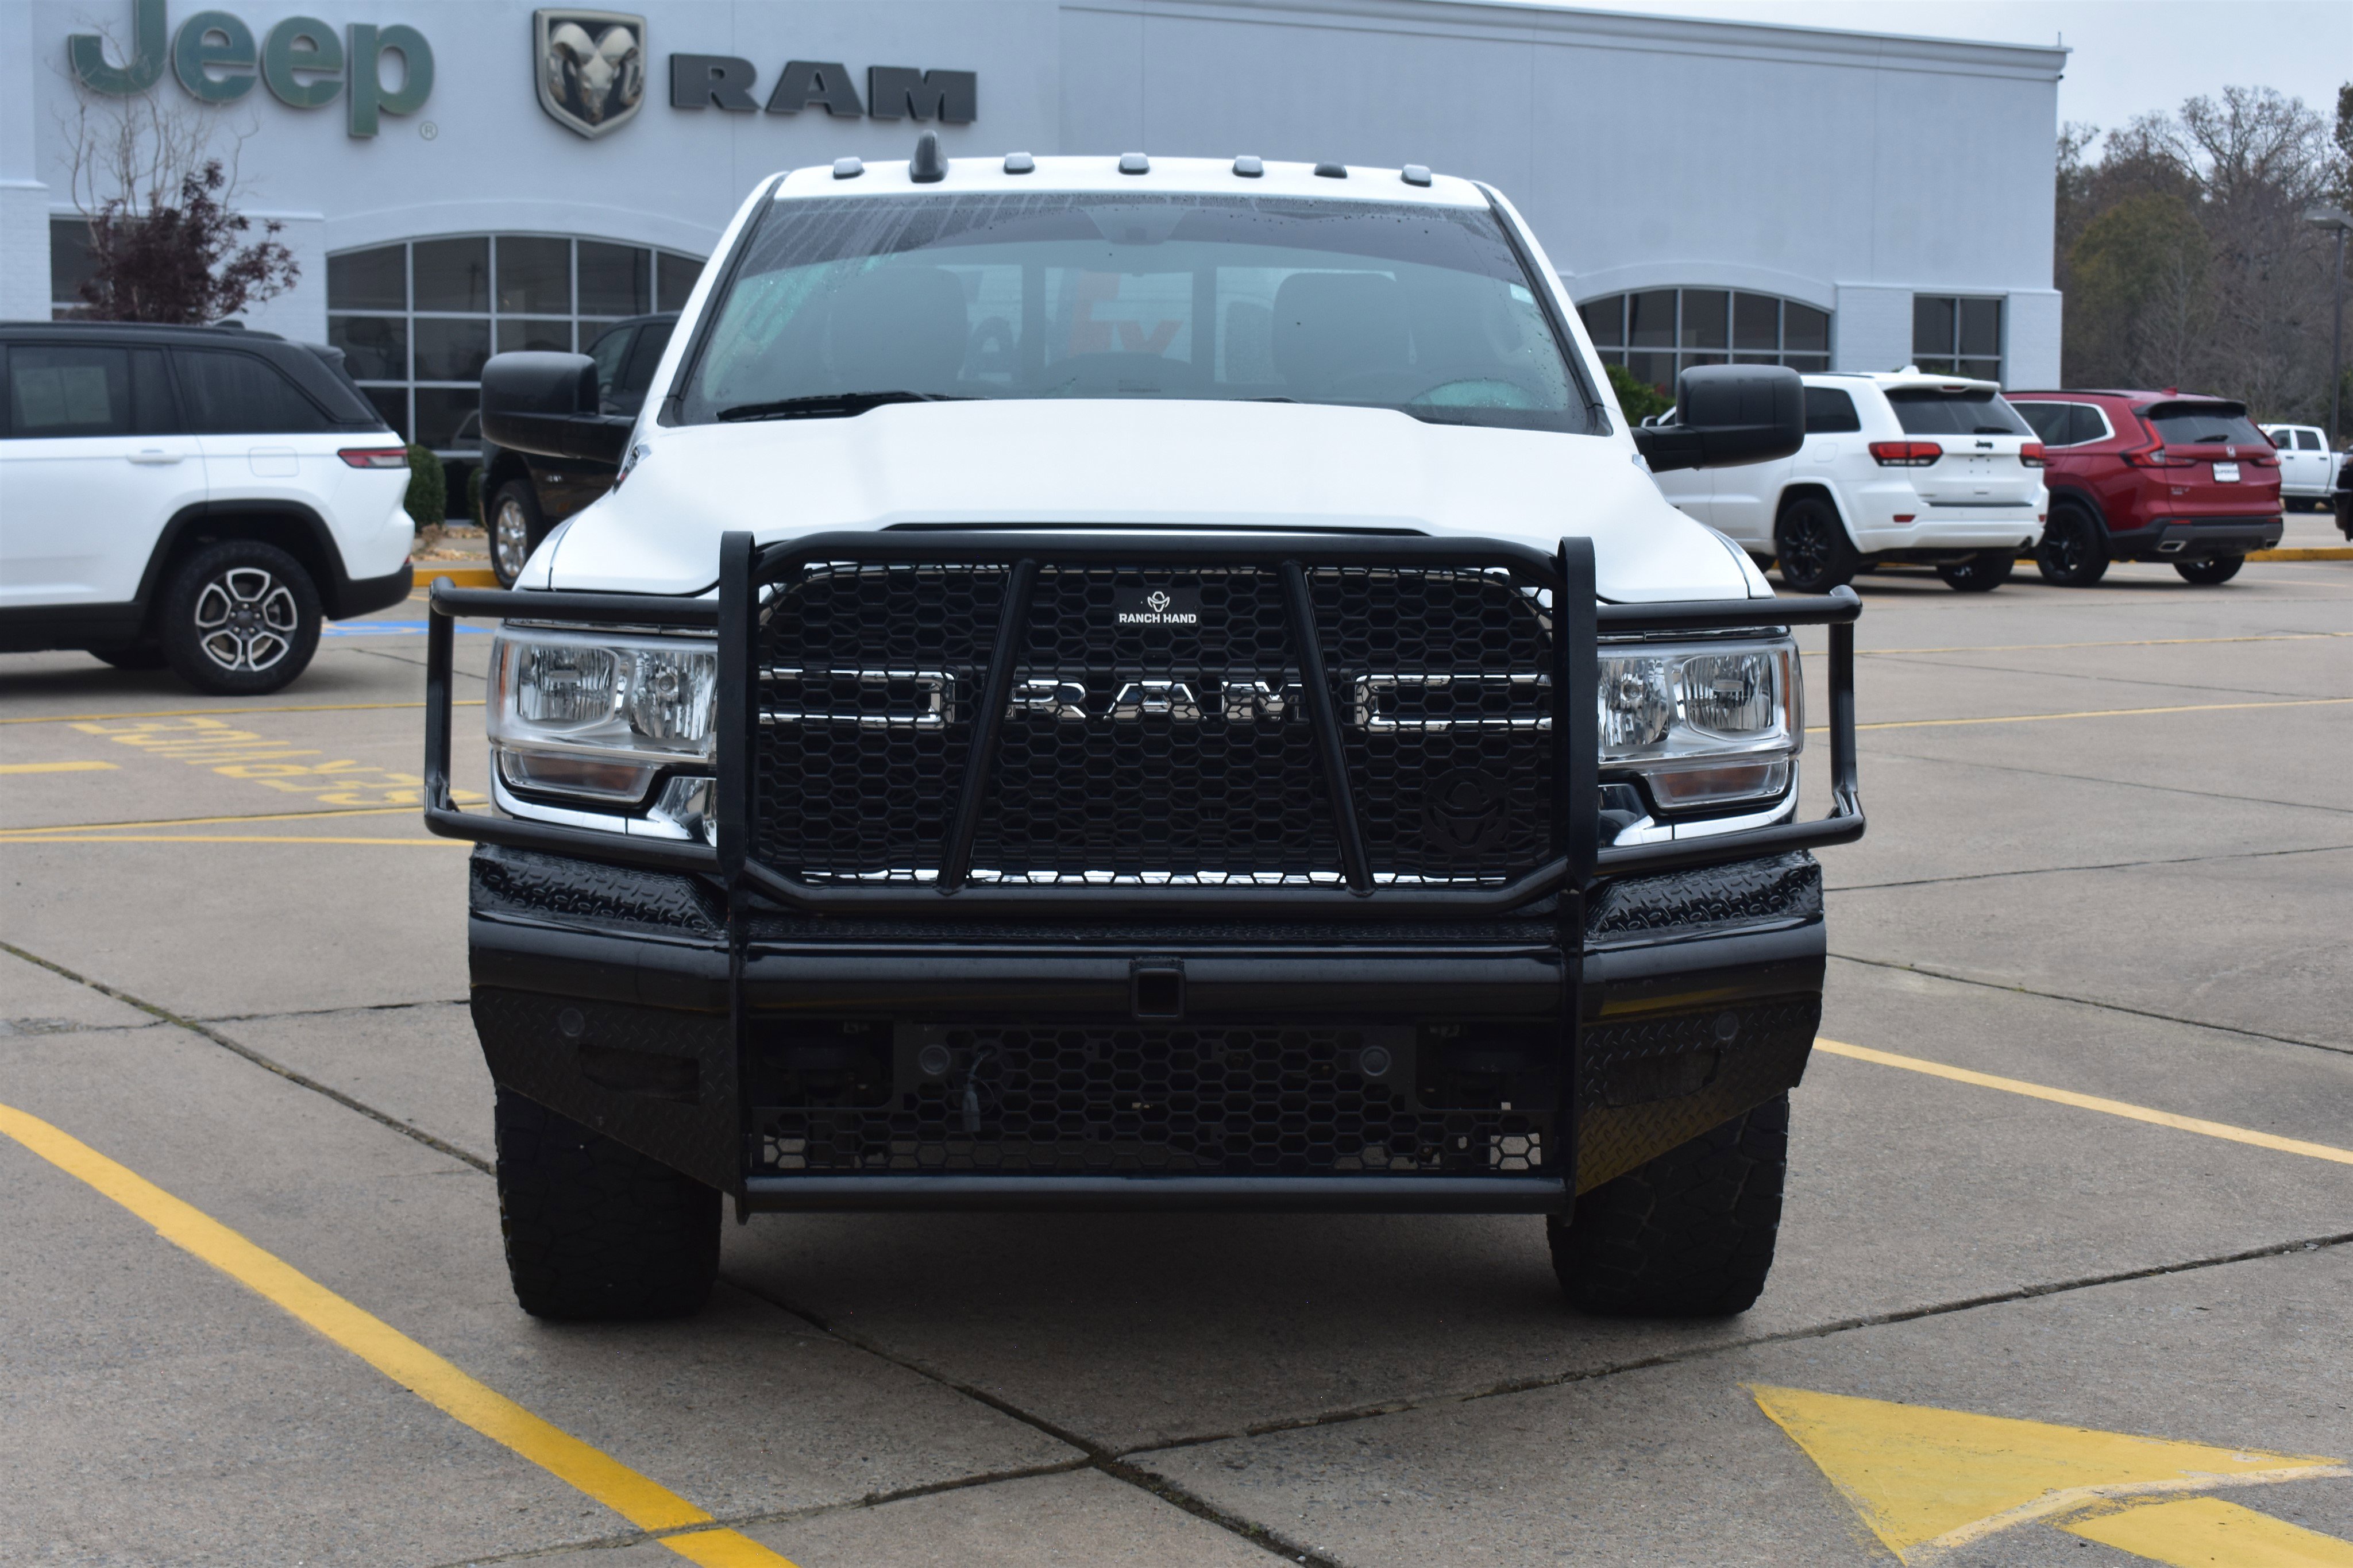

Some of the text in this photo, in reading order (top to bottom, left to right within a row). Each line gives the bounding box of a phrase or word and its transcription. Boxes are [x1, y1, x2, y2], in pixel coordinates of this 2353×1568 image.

[68, 0, 435, 138] Jeep
[669, 53, 978, 123] RAM
[1119, 613, 1197, 624] RANCH HAND
[1004, 679, 1312, 723] RAM
